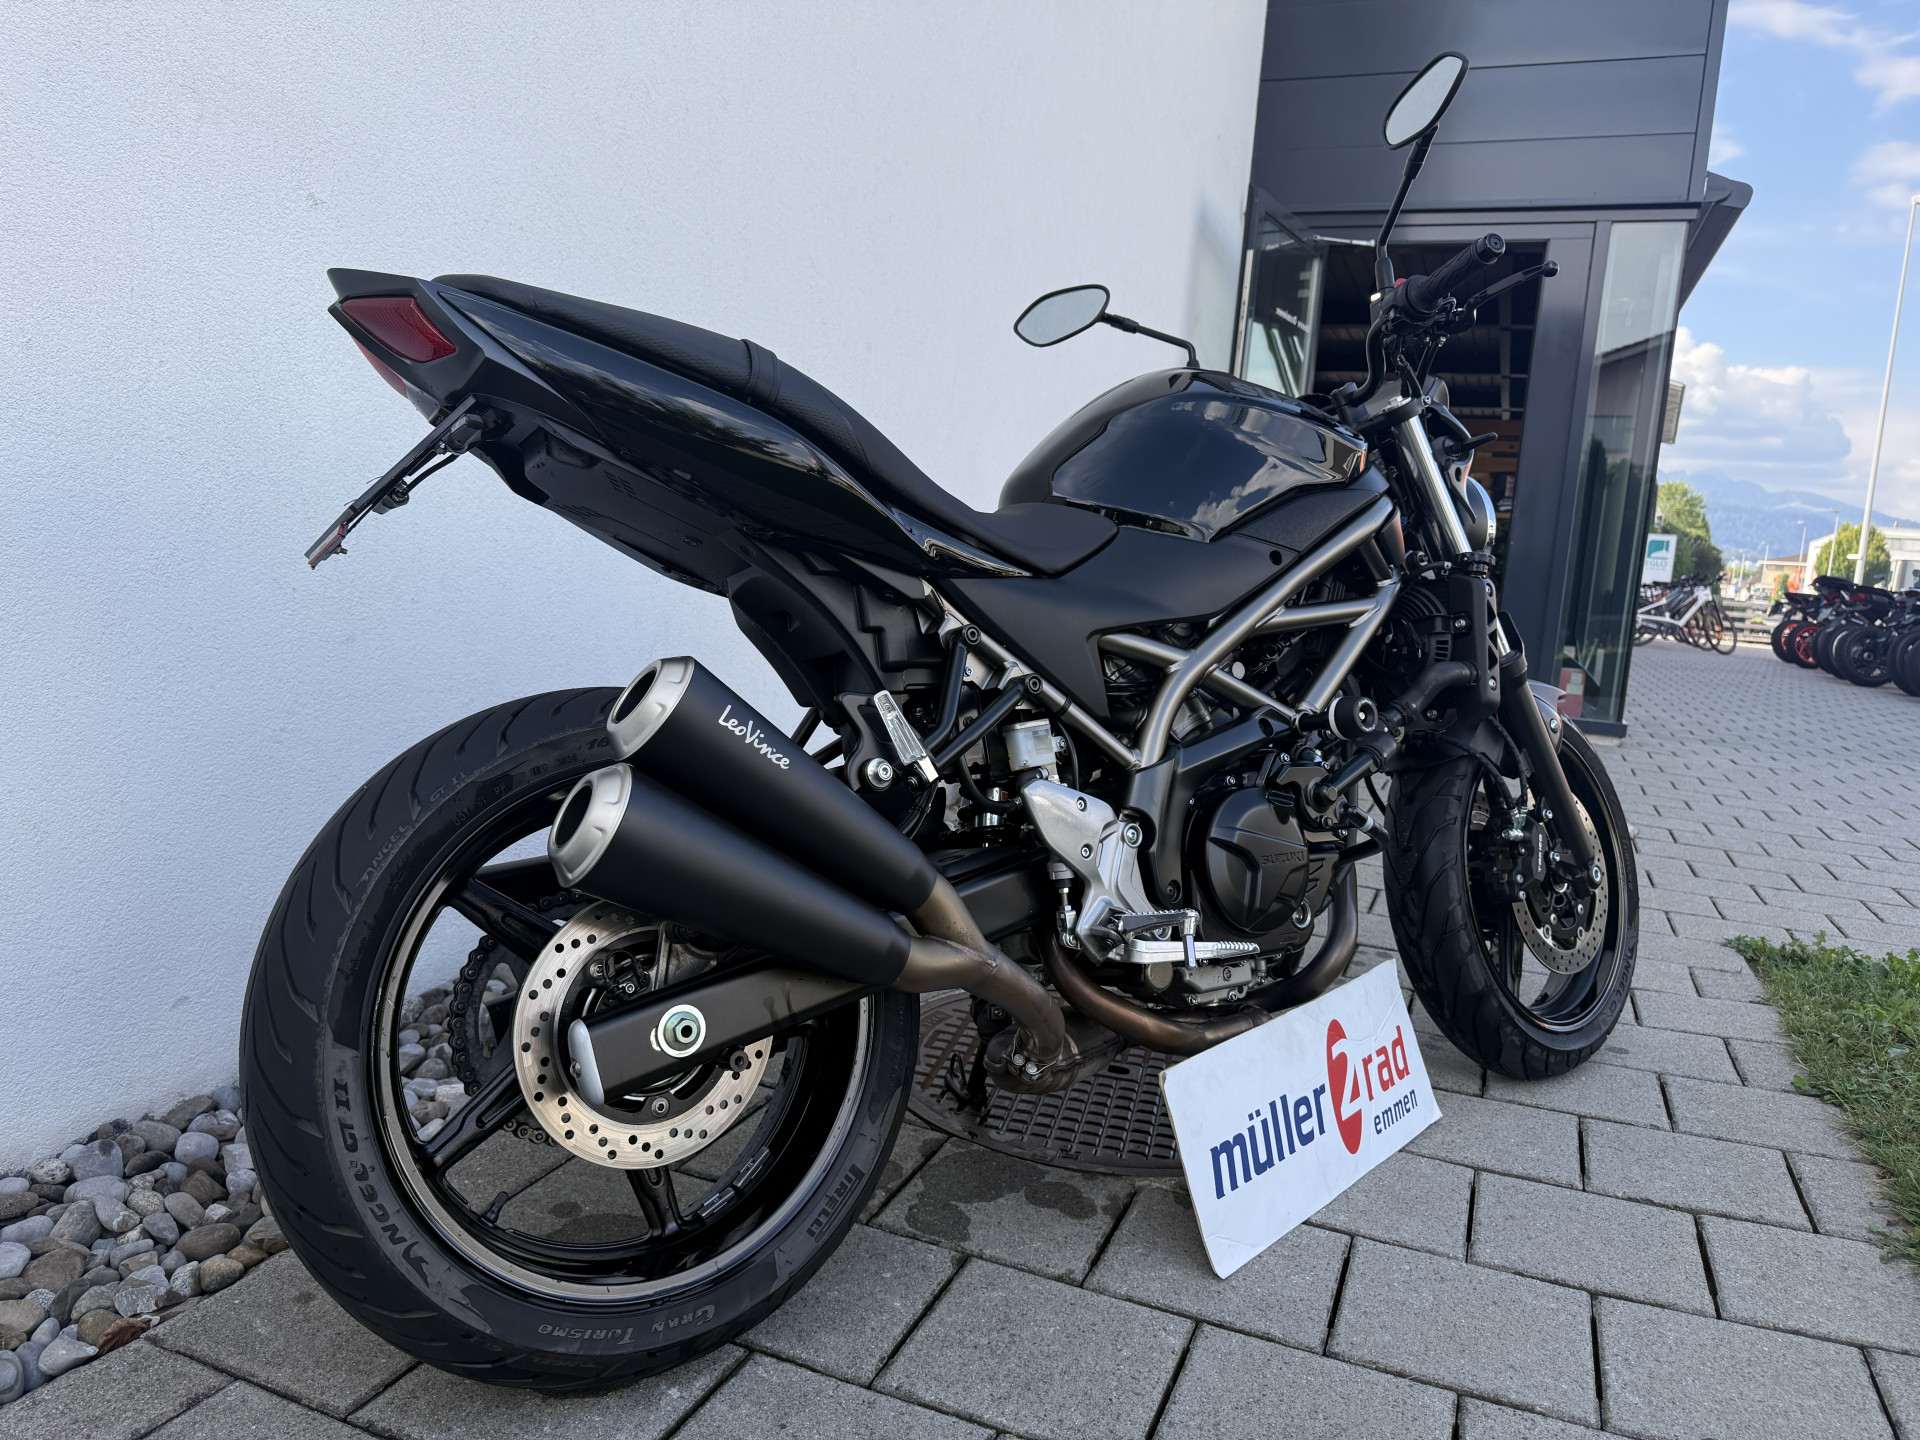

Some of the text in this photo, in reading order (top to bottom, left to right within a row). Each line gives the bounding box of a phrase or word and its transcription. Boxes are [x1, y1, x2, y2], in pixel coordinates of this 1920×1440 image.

[717, 703, 791, 770] LeoVince
[1261, 850, 1306, 866] SUZUKI
[1616, 941, 1638, 997] ANGEL
[1209, 1083, 1327, 1200] müller
[1373, 1087, 1419, 1135] emmen
[353, 1162, 431, 1289] ANGEL
[806, 1162, 866, 1243] PIRELLI
[536, 1304, 716, 1345] GRAN TURISMO
